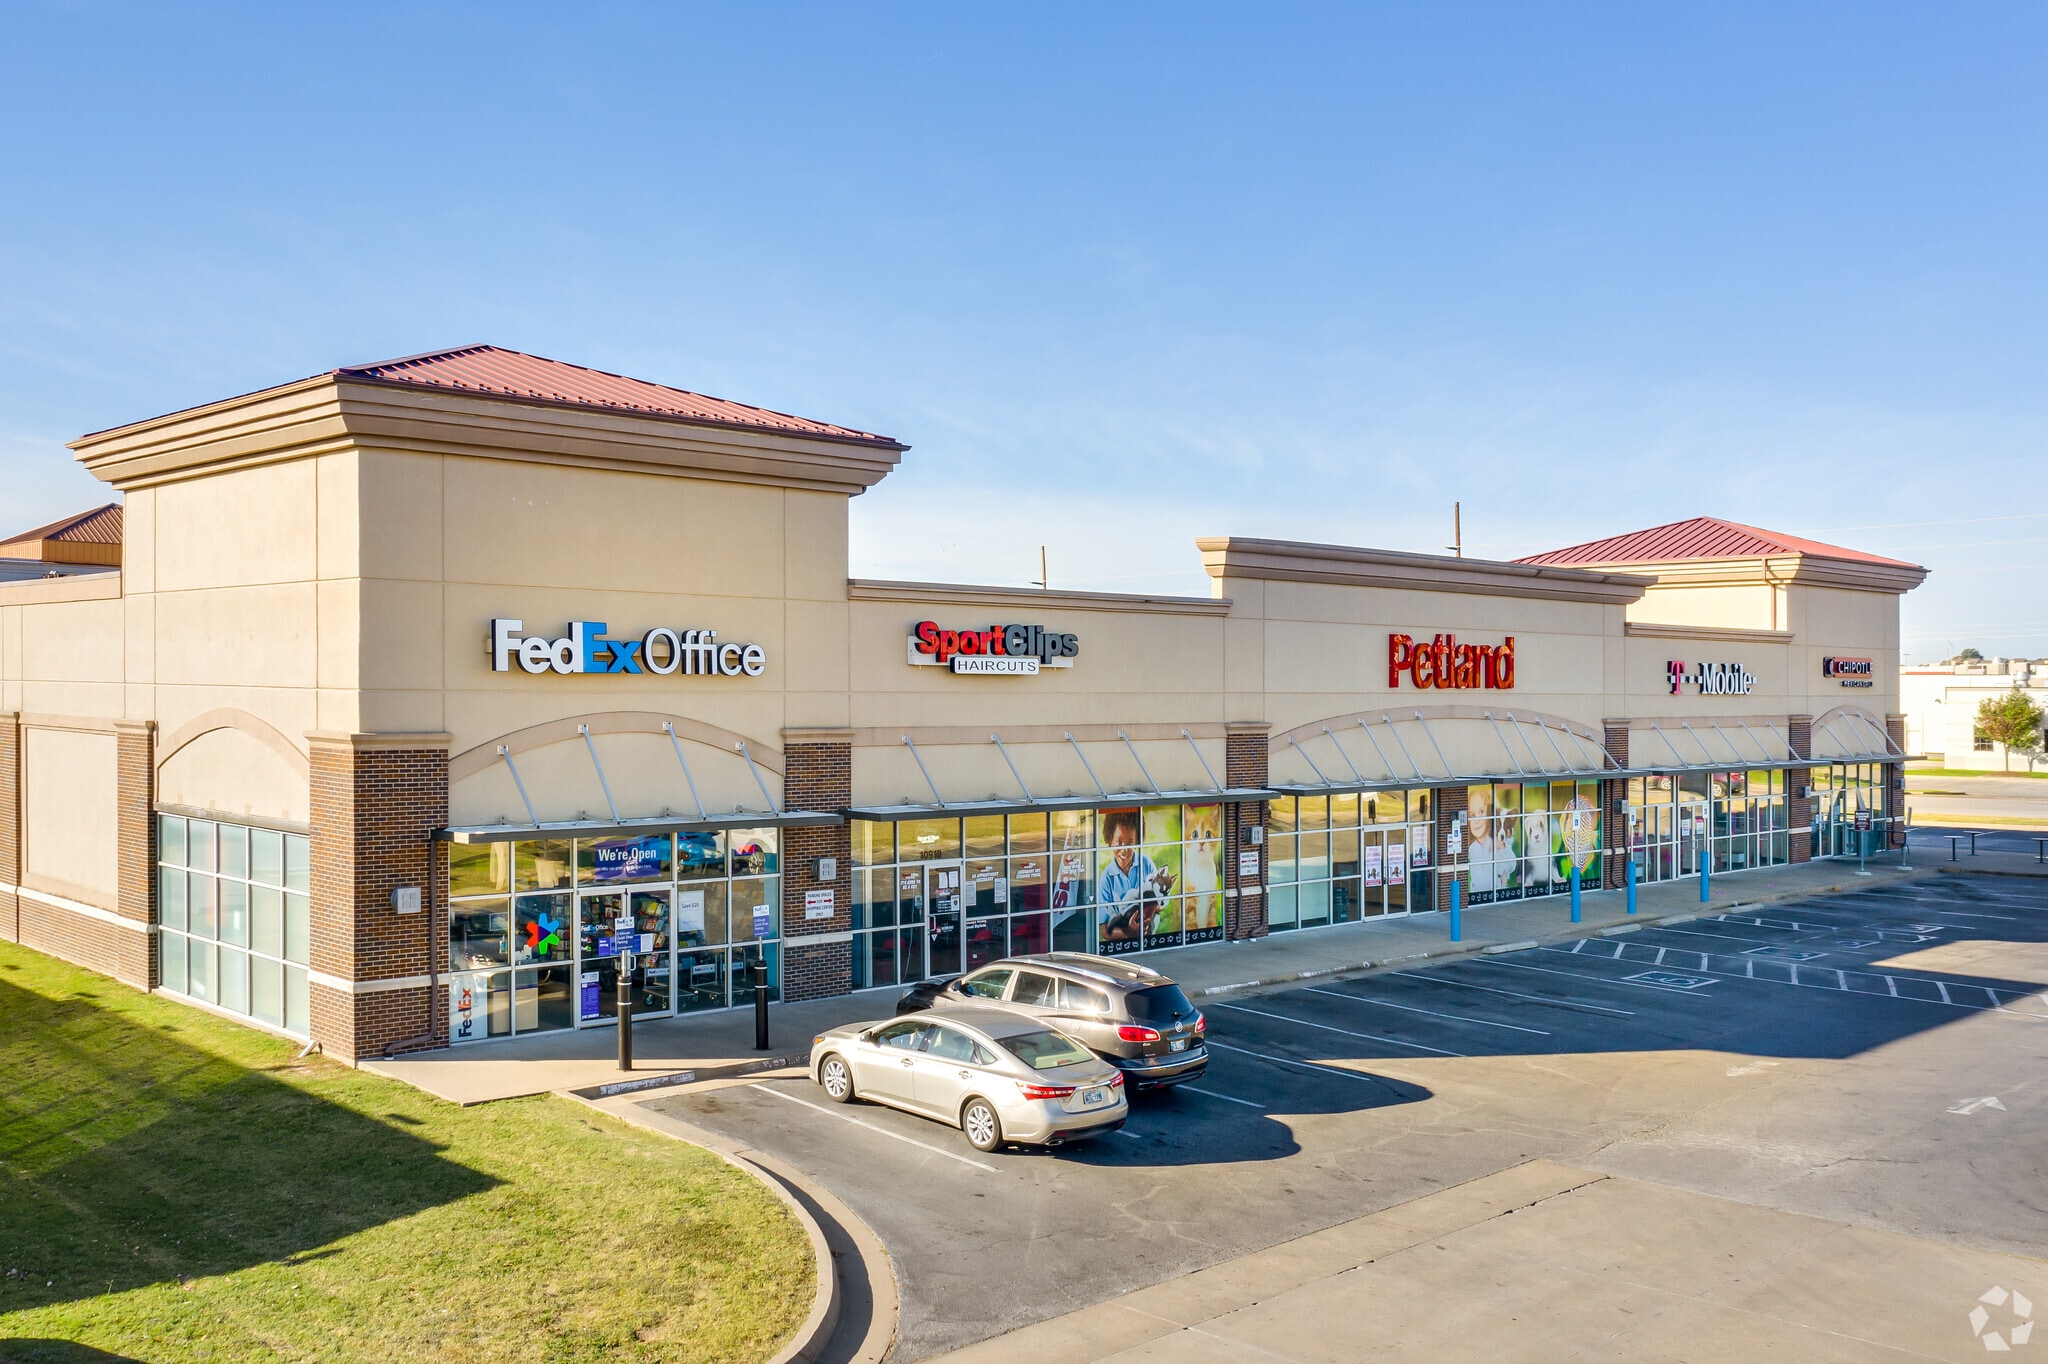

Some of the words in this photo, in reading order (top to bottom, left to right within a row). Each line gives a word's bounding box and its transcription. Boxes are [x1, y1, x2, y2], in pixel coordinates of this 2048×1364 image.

[491, 618, 643, 674] FedEx
[641, 627, 766, 677] Office
[915, 620, 1078, 664] SportClips
[1388, 633, 1515, 689] Petland
[957, 660, 1036, 672] HAIRCUTS
[1838, 661, 1873, 674] CHIPOTLE
[598, 848, 628, 862] We're
[631, 847, 657, 862] Open
[458, 987, 472, 1038] FedEx
